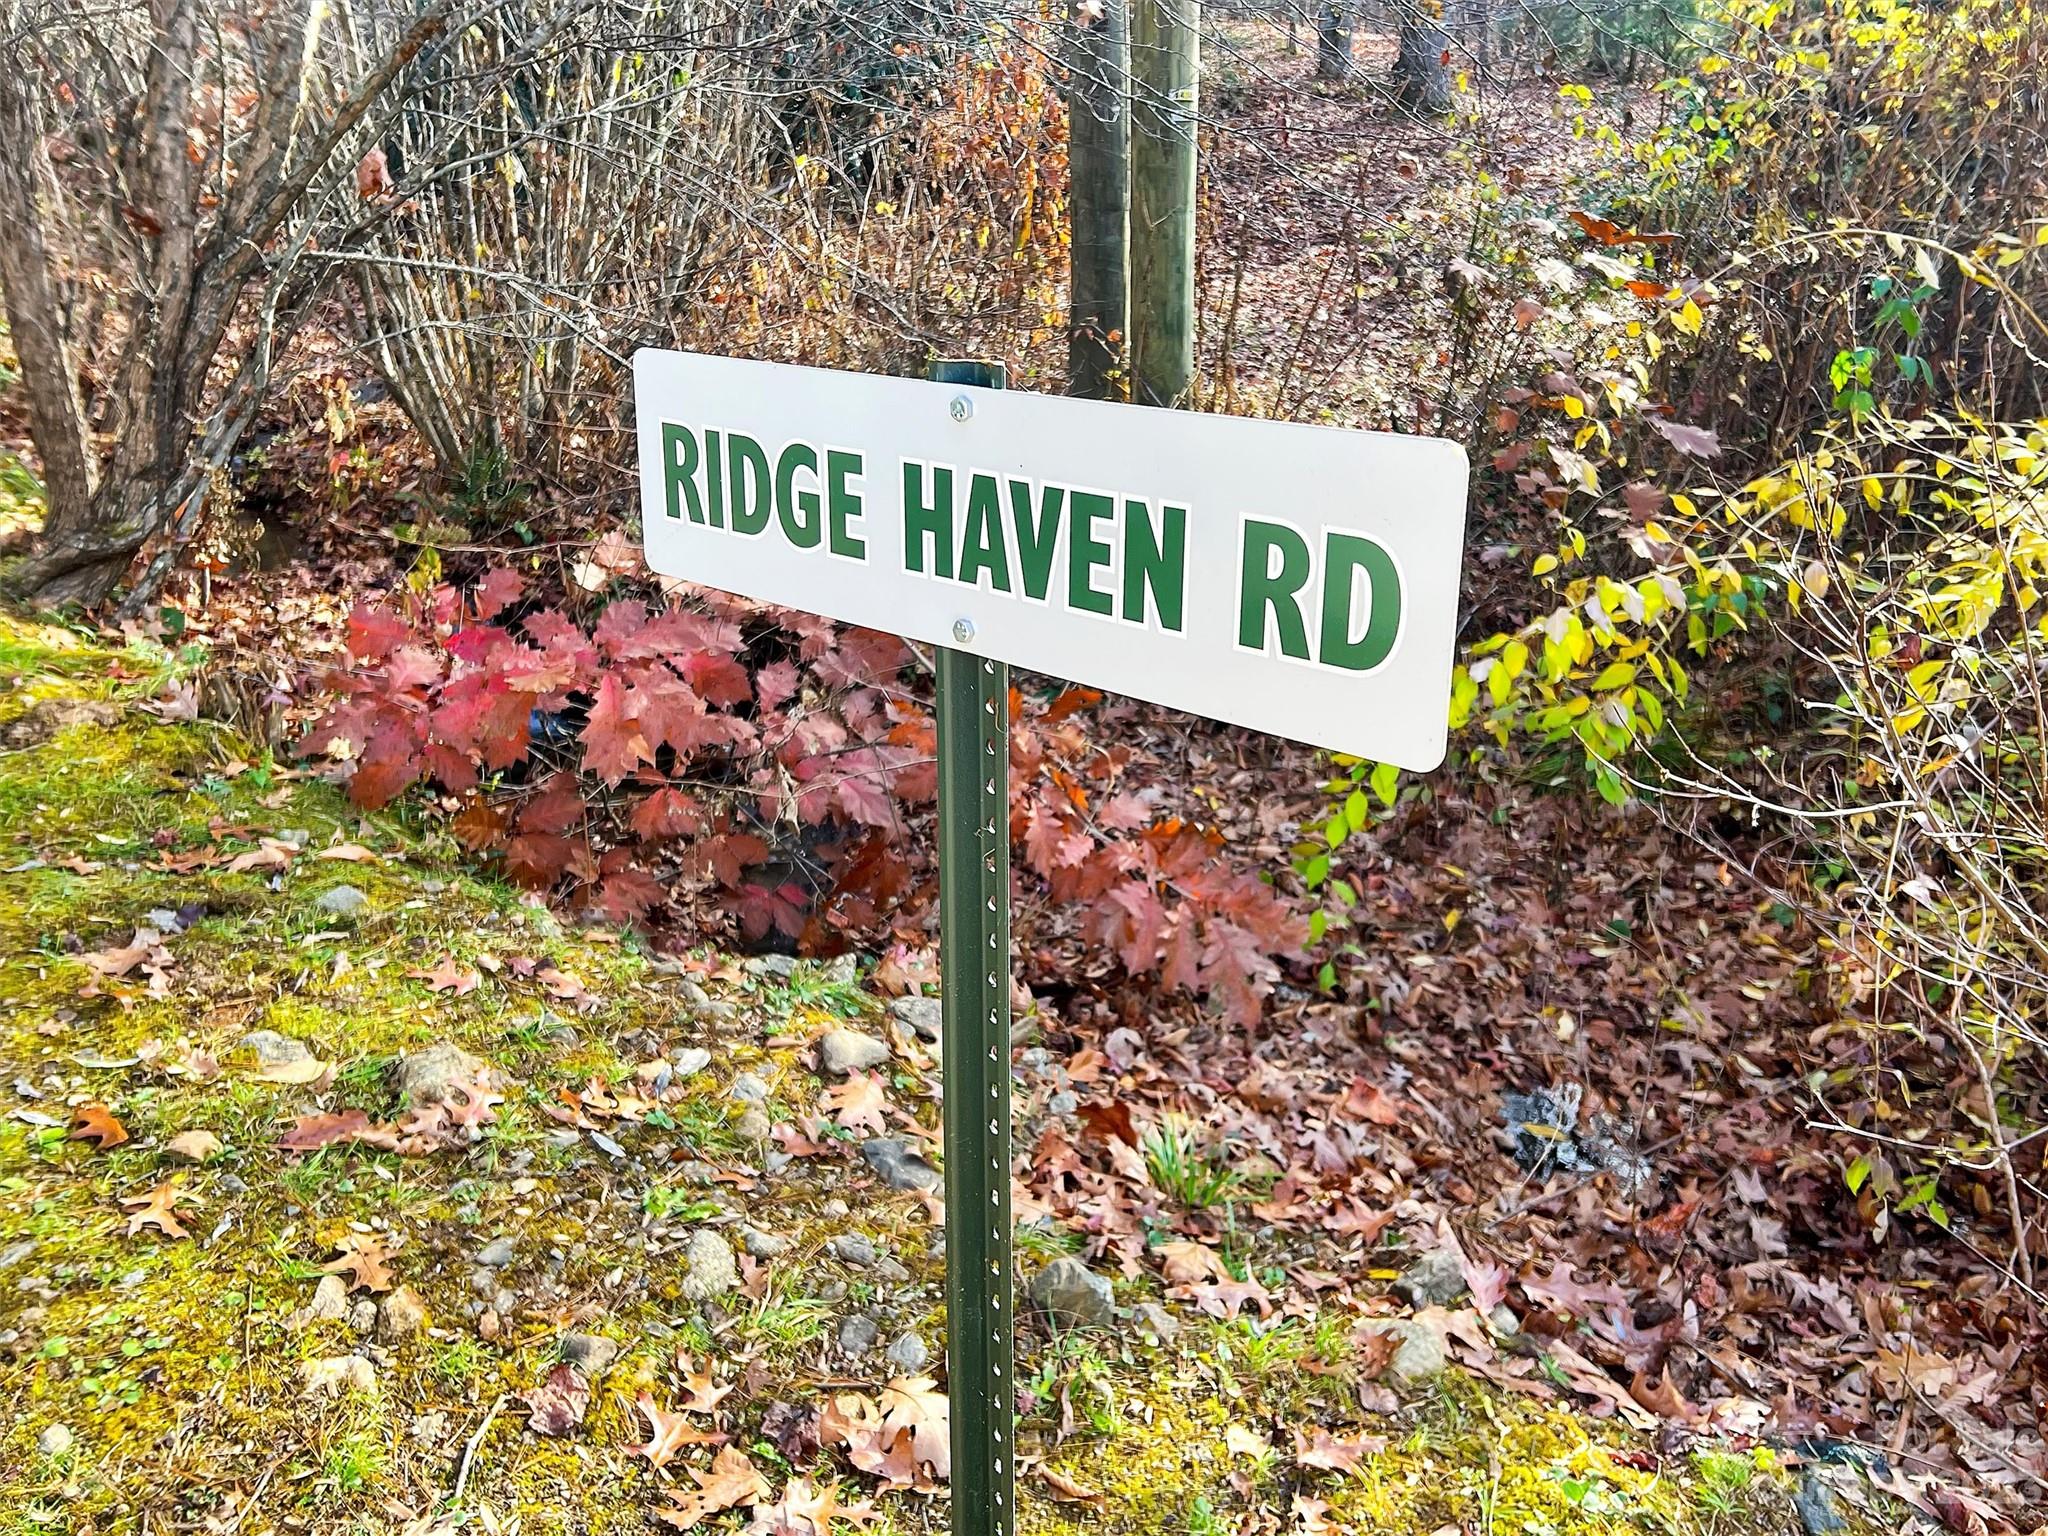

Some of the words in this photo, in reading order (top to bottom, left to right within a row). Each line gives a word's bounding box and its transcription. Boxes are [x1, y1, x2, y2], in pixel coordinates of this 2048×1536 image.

[663, 424, 865, 559] RIDGE
[903, 463, 1186, 631] HAVEN
[1239, 521, 1401, 671] RD
